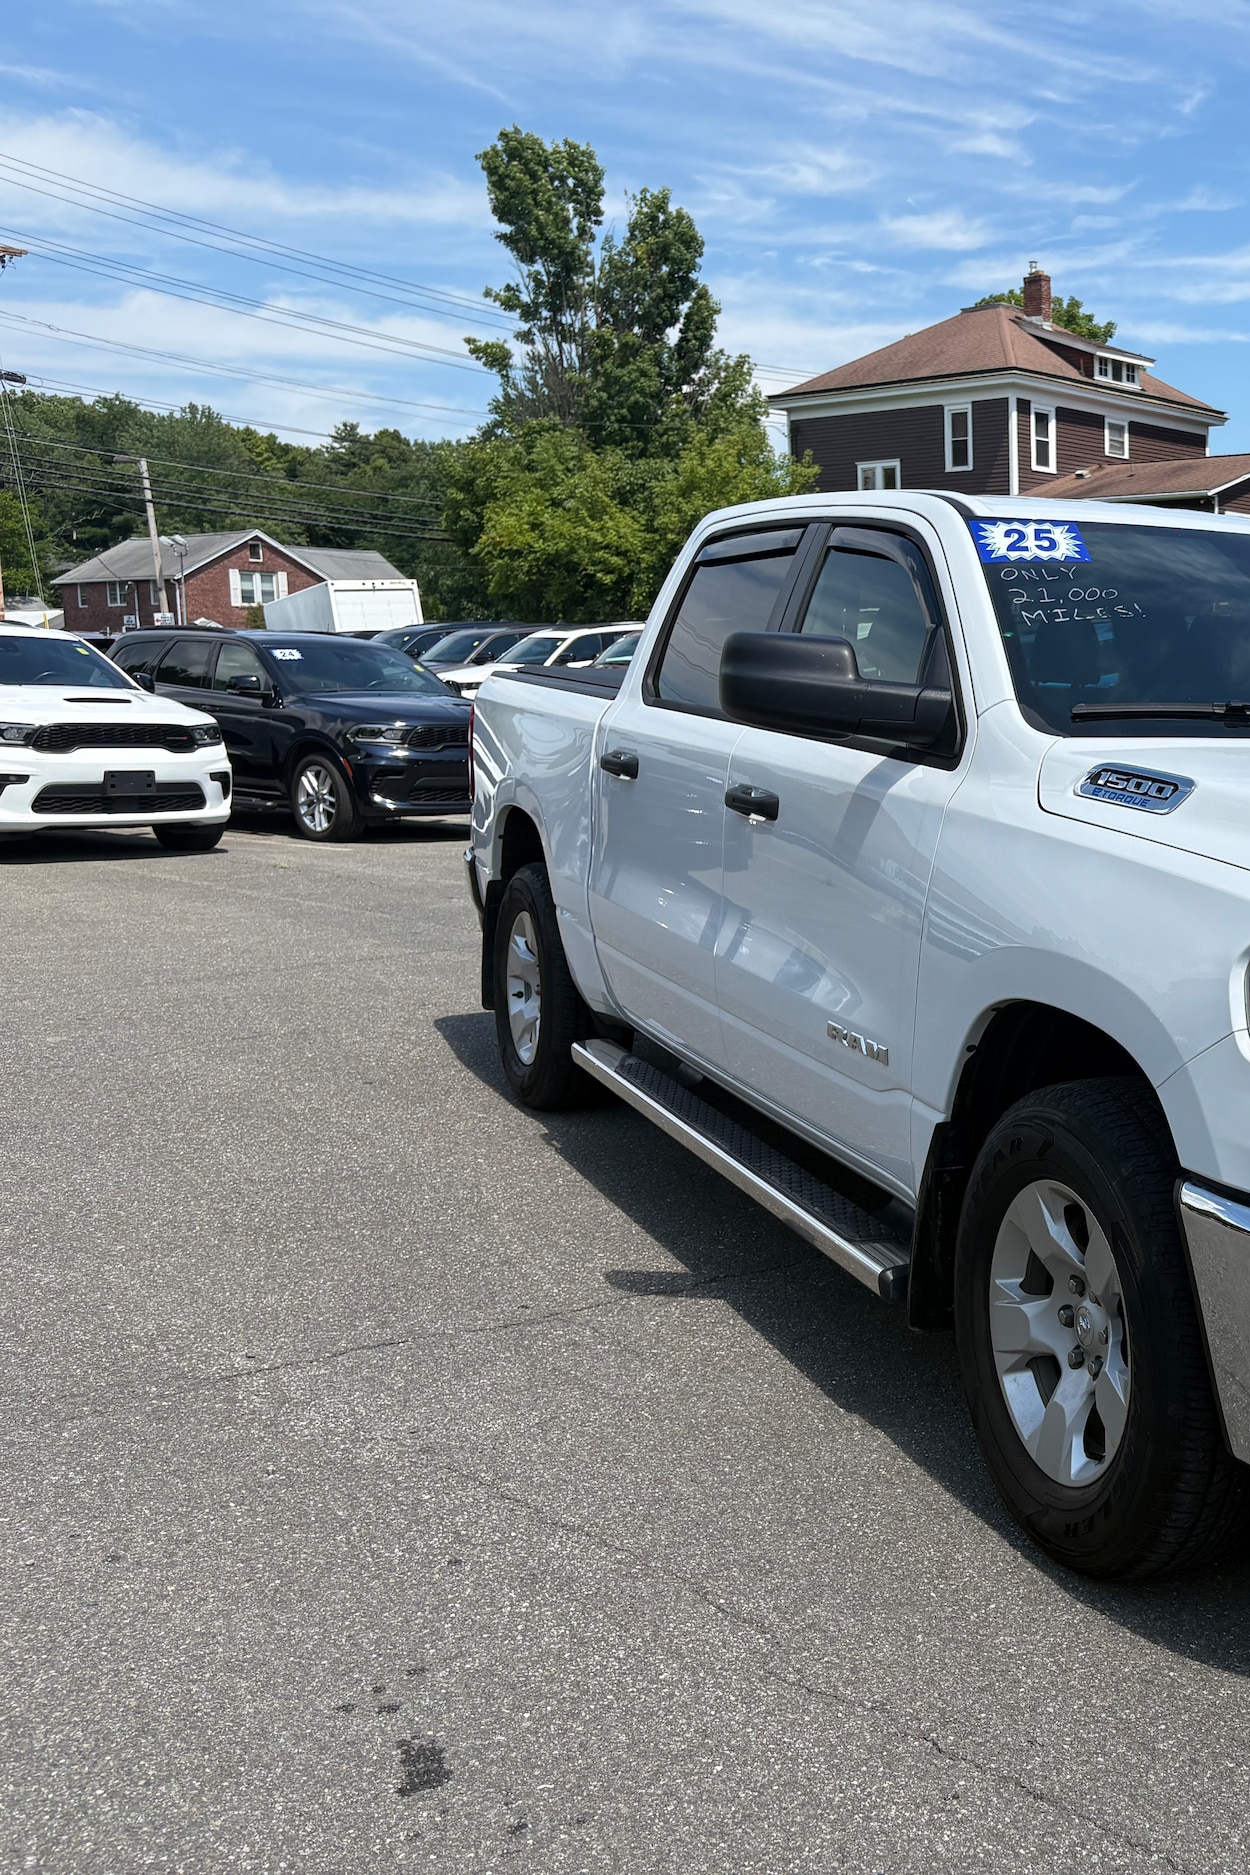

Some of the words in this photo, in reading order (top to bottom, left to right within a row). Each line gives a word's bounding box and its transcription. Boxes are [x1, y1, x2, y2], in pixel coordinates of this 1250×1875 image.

[1003, 528, 1059, 552] 25
[1000, 566, 1077, 580] ONLY
[1008, 588, 1118, 604] 21,000
[1021, 603, 1146, 626] MILES!
[1097, 771, 1175, 799] 1500
[826, 1020, 889, 1066] RAM
